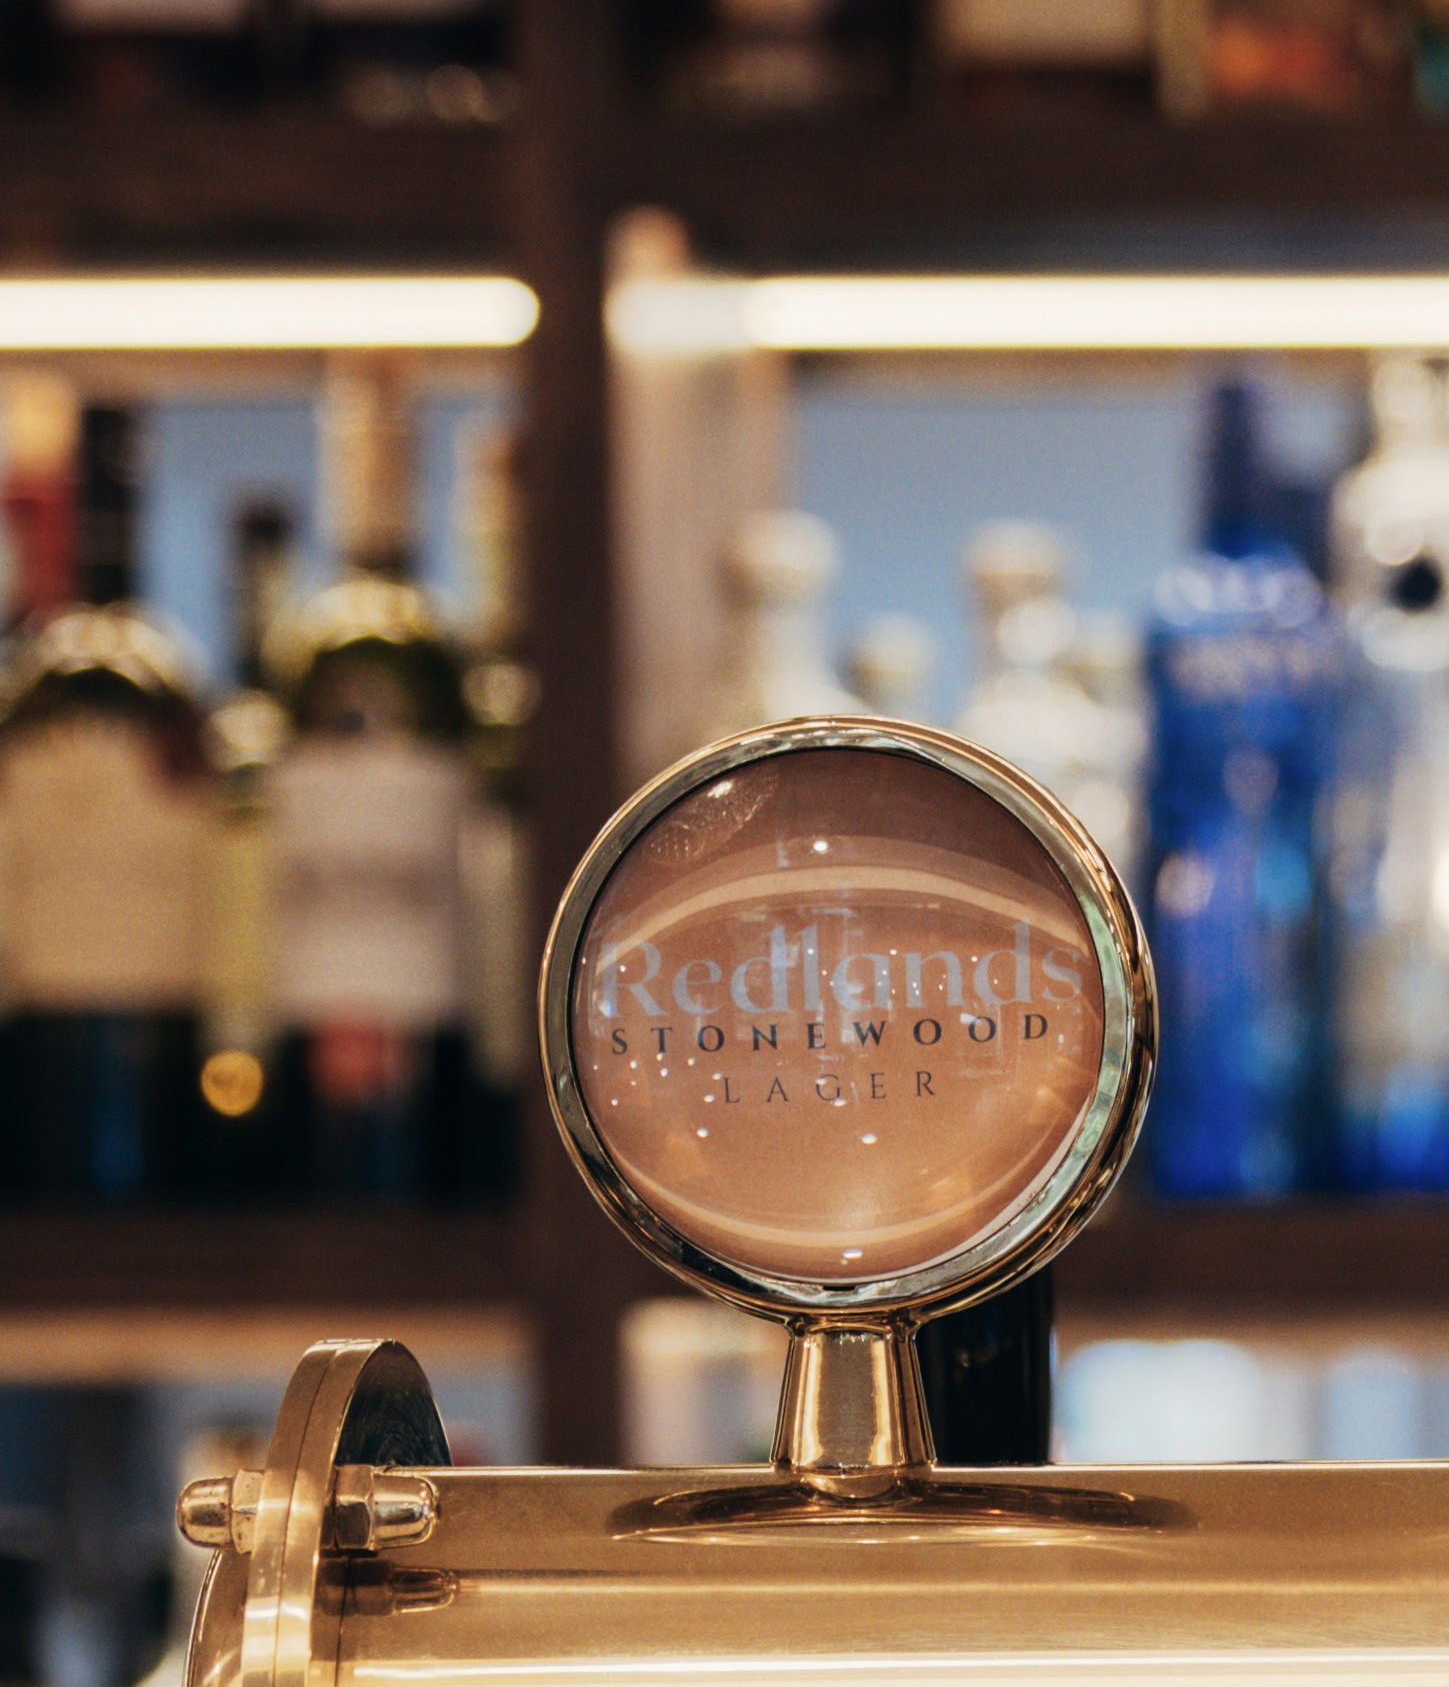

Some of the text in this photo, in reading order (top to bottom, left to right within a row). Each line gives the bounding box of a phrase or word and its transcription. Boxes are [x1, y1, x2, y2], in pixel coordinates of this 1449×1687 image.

[602, 917, 1083, 1018] Redlands
[611, 1013, 1049, 1055] STONEWOOD
[723, 1070, 936, 1105] LAGER
